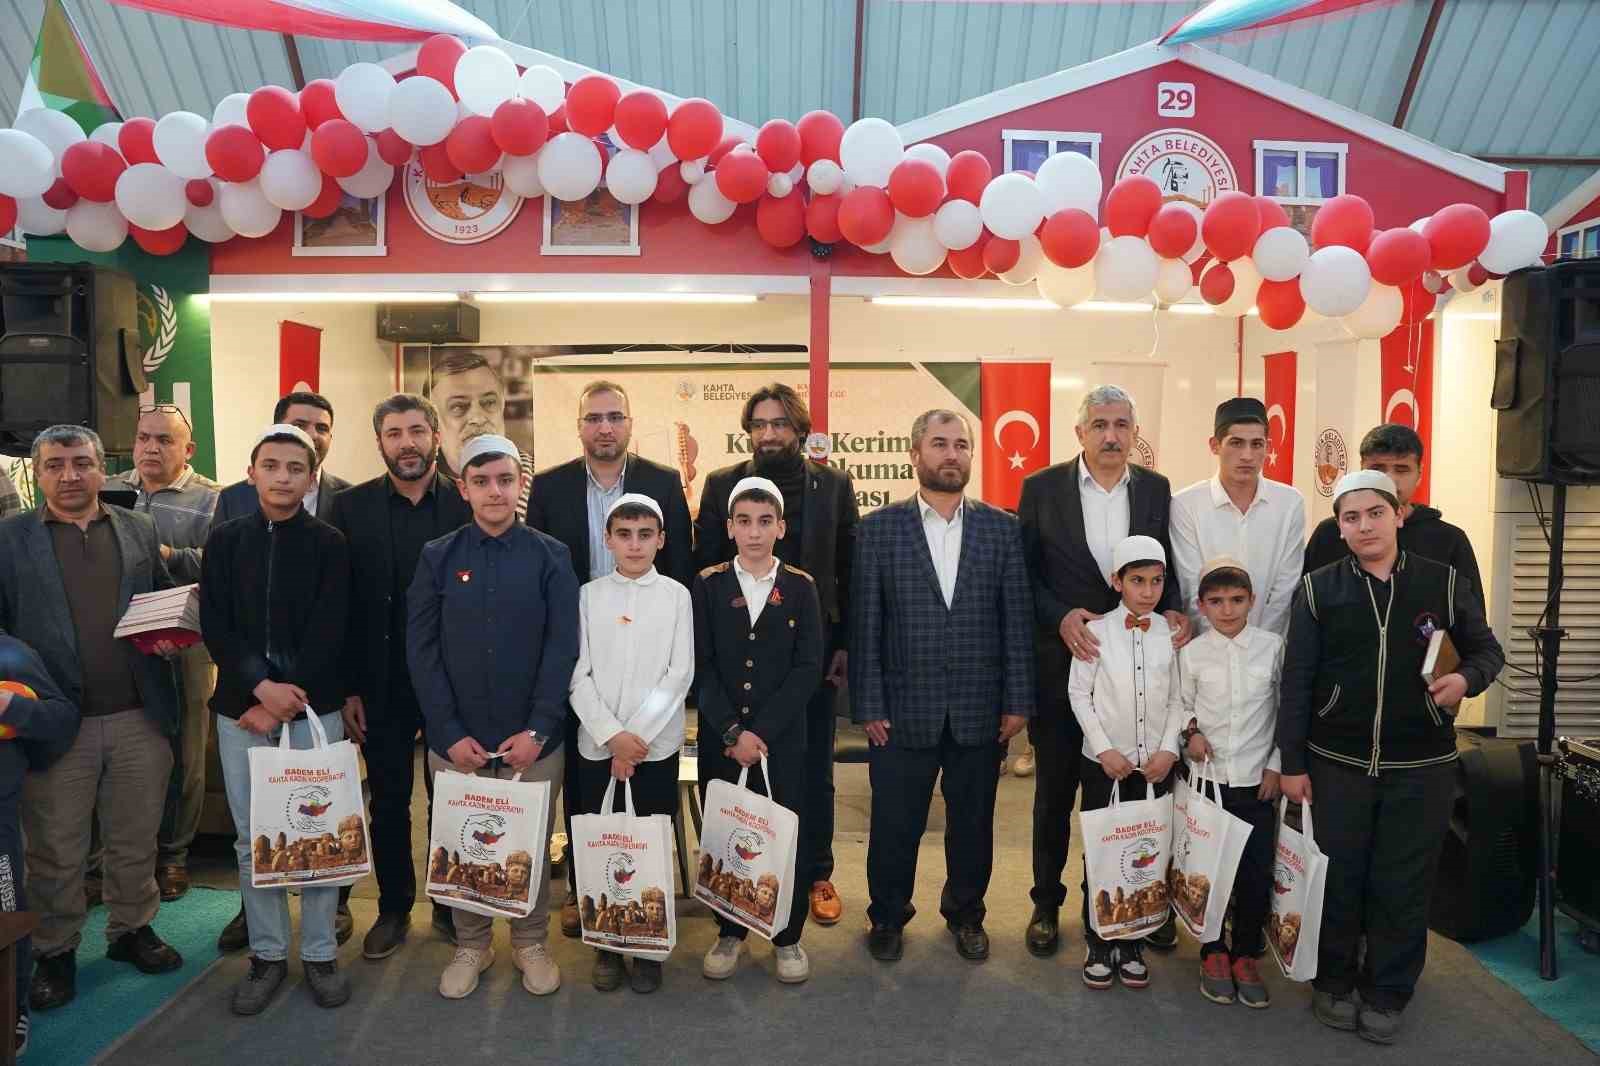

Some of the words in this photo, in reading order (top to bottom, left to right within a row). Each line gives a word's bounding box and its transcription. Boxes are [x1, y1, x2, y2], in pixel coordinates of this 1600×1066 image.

[1160, 89, 1192, 110] 29
[1129, 144, 1161, 175] AHTA
[454, 224, 479, 234] 1923
[703, 384, 735, 392] KAHTA
[703, 391, 752, 401] BELEDİYES
[831, 430, 912, 453] Kerim
[284, 768, 314, 776] BADEM
[464, 793, 494, 804] BADEM
